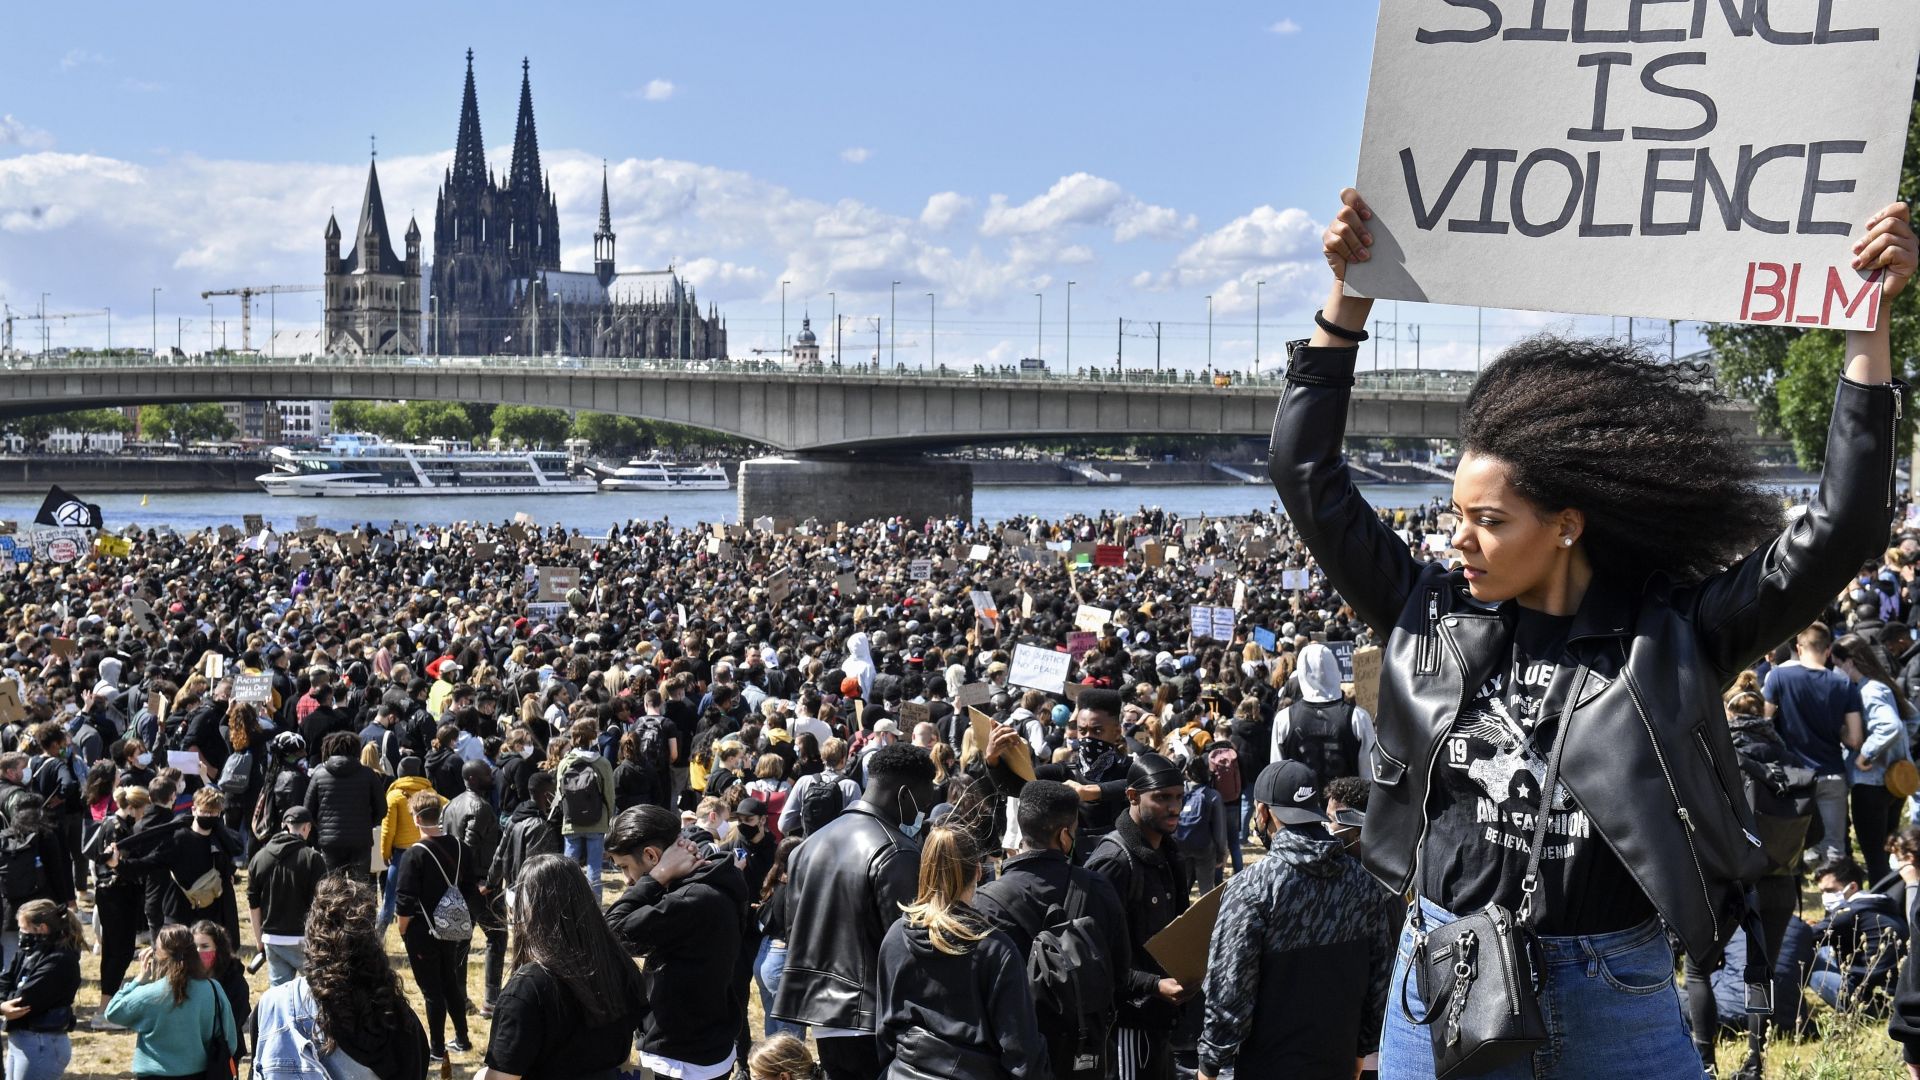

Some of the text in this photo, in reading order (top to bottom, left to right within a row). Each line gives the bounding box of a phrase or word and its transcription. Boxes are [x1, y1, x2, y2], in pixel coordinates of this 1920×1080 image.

[1567, 51, 1718, 142] IS
[1399, 140, 1868, 237] VIOLENCE
[1740, 262, 1882, 328] BLM
[1447, 738, 1467, 763] 19
[1541, 842, 1575, 859] DENIM
